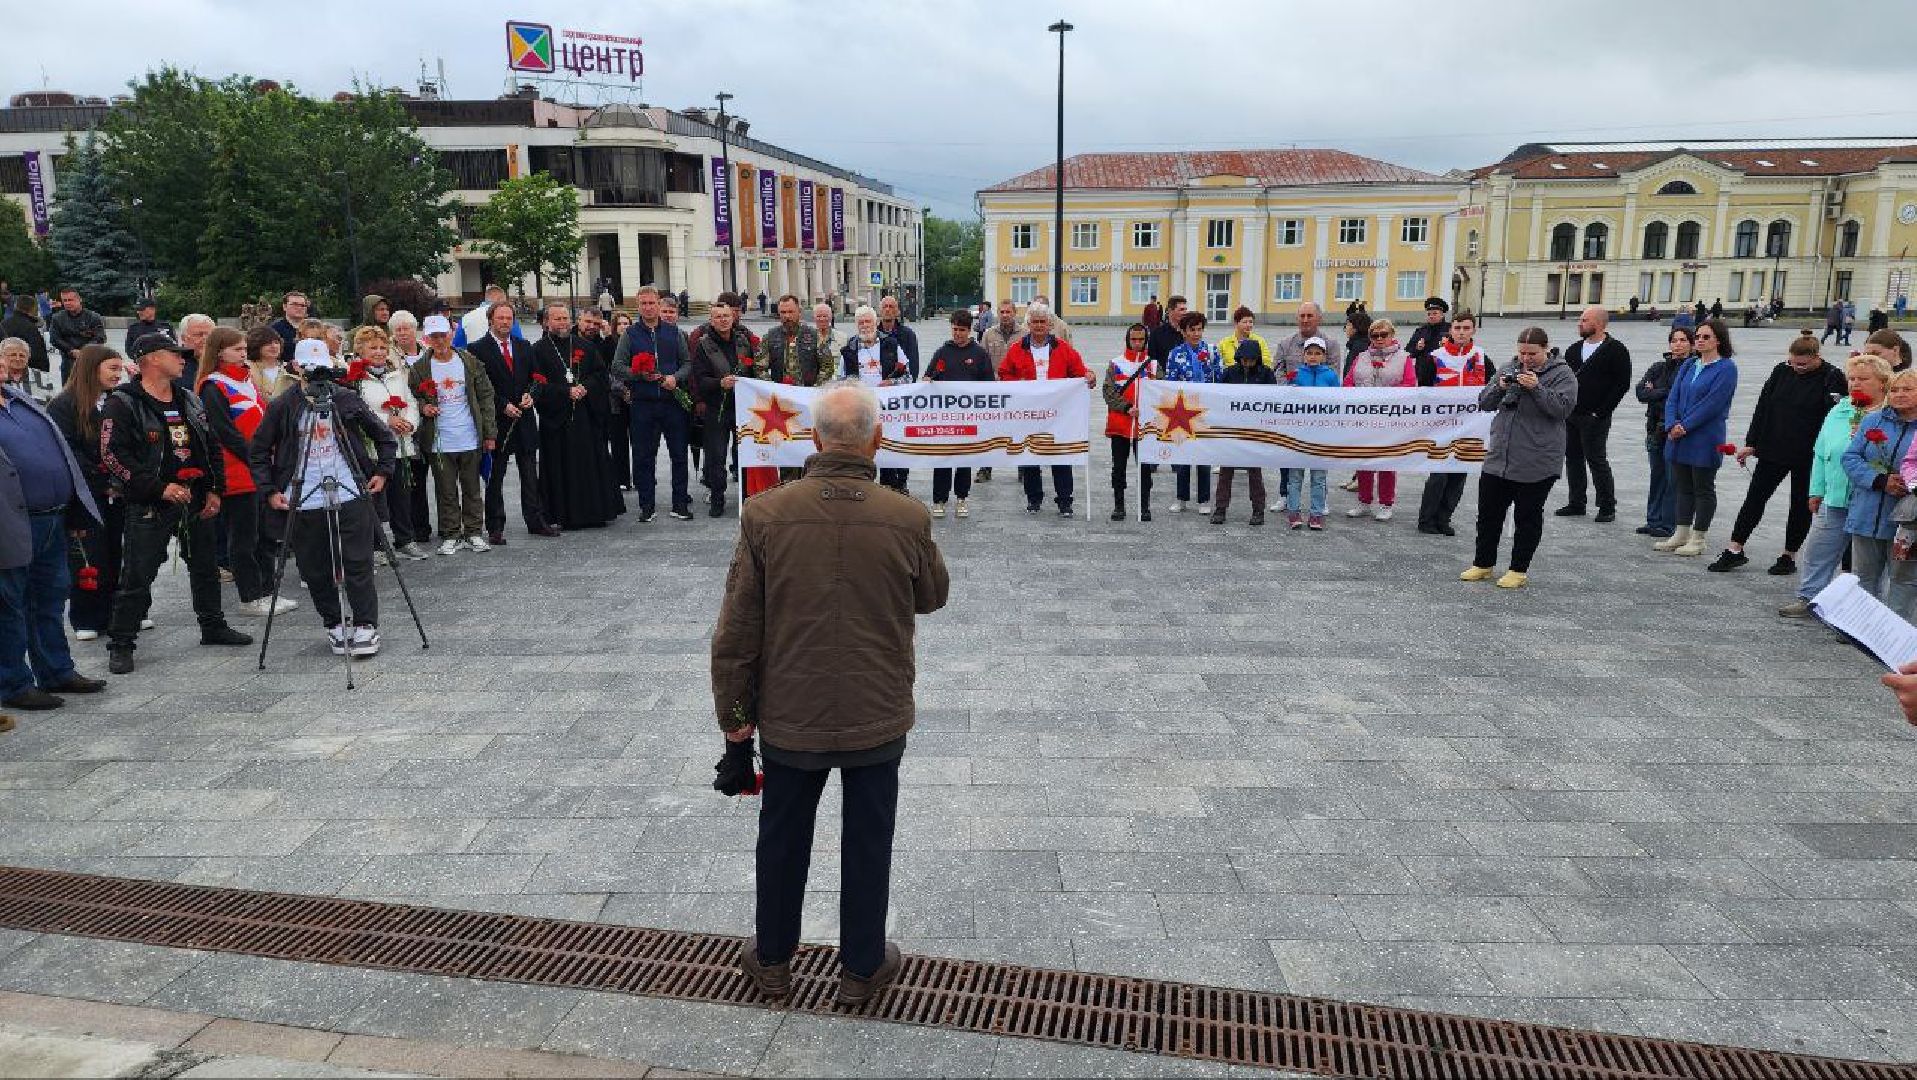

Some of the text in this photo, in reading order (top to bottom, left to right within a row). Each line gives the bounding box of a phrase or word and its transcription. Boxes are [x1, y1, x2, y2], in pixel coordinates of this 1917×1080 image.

[562, 43, 643, 82] центр
[762, 177, 774, 227] familia
[801, 186, 812, 231] familia
[832, 193, 843, 234] familia
[1230, 401, 1482, 417] НАСЛЕДНИКИ ПОБЕДЫ В СТРО
